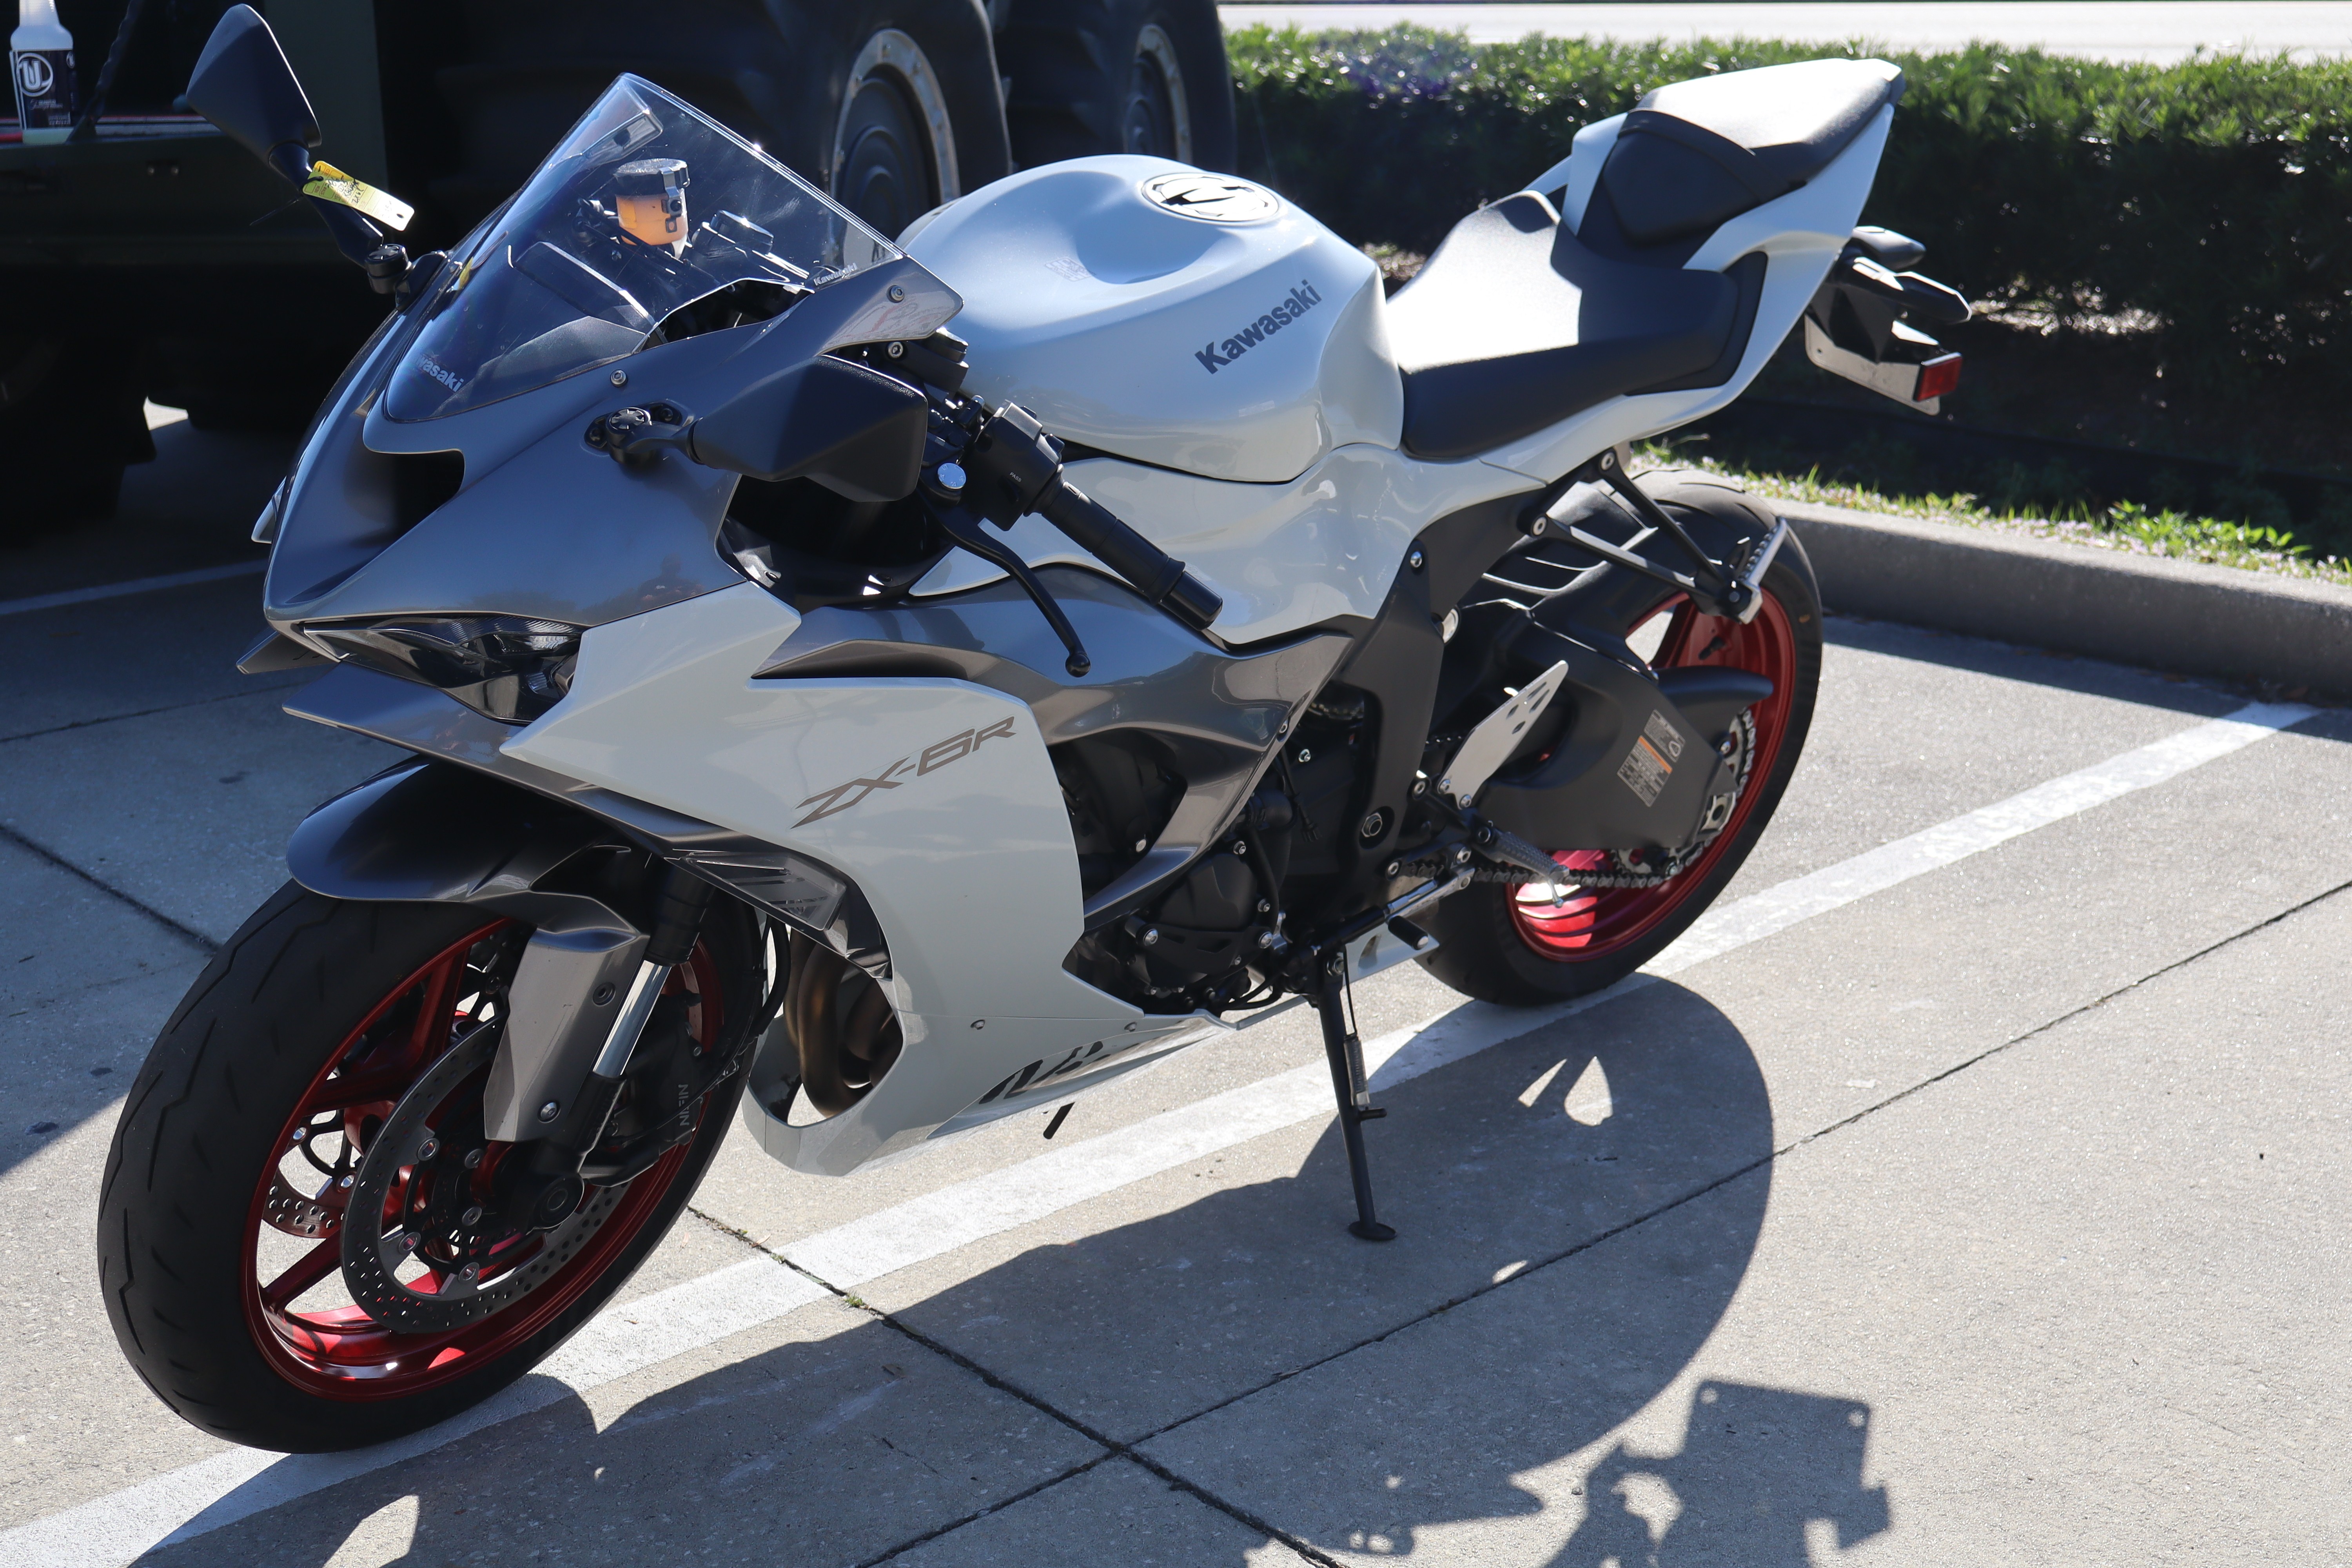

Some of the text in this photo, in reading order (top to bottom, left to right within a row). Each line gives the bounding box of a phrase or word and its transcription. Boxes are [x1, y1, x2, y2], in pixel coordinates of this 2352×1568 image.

[813, 262, 858, 286] Kawasaki
[1194, 279, 1322, 374] Kawasaki
[416, 355, 465, 392] wasaki
[1009, 472, 1022, 483] PASS
[789, 716, 1017, 829] ZX-6R
[677, 1083, 691, 1127] NISIN
